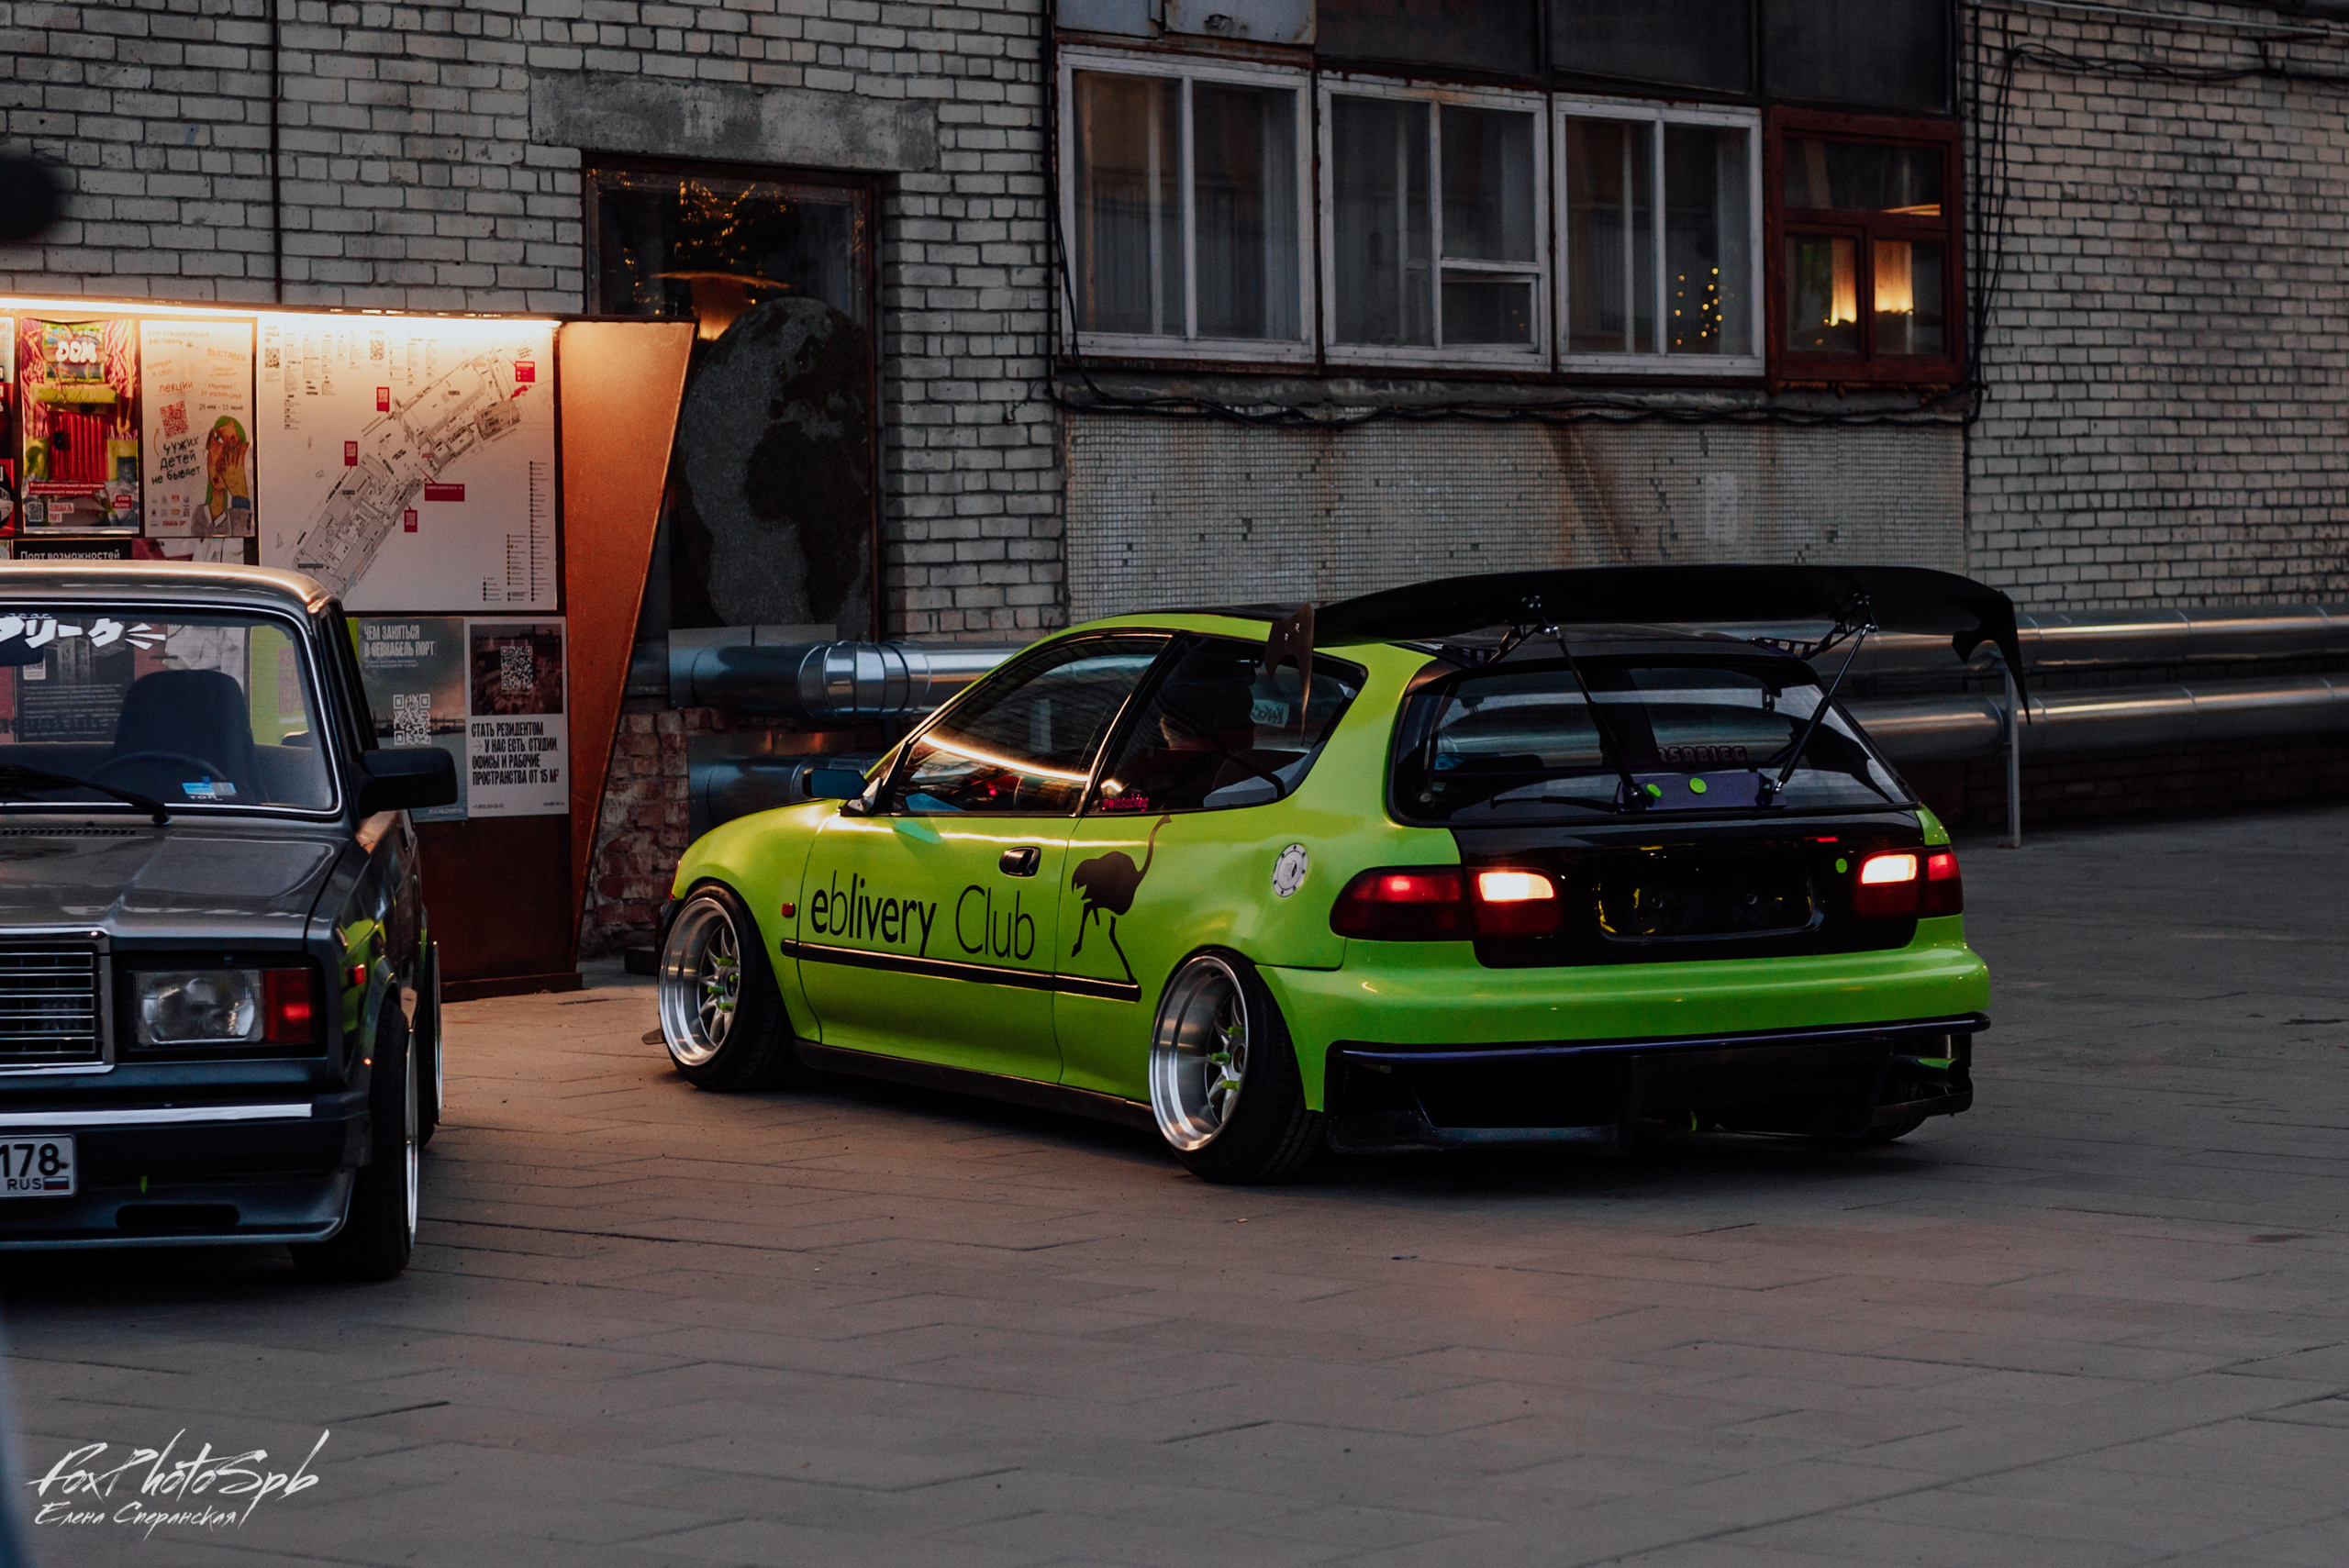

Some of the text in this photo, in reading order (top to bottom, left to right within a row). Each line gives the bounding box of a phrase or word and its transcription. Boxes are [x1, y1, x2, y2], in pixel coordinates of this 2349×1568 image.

[20, 550, 120, 561] Порт возможностей
[363, 625, 420, 640] ЧЕМ ЗАНЯТЬСЯ
[364, 642, 370, 657] В
[371, 641, 414, 657] СЕВКАБЕЛЬ
[471, 721, 544, 738] СТАТЬ РЕЗИДЕНТОМ
[484, 740, 490, 753] У
[492, 739, 506, 753] НАС
[472, 753, 540, 770] ОФИСЫ И РАБОЧИЕ
[473, 770, 528, 786] ПРОСТРАНСТВА
[529, 770, 538, 784] ОТ
[540, 769, 548, 784] 15
[810, 870, 1035, 961] eblivery Club
[6, 1177, 42, 1192] RUS
